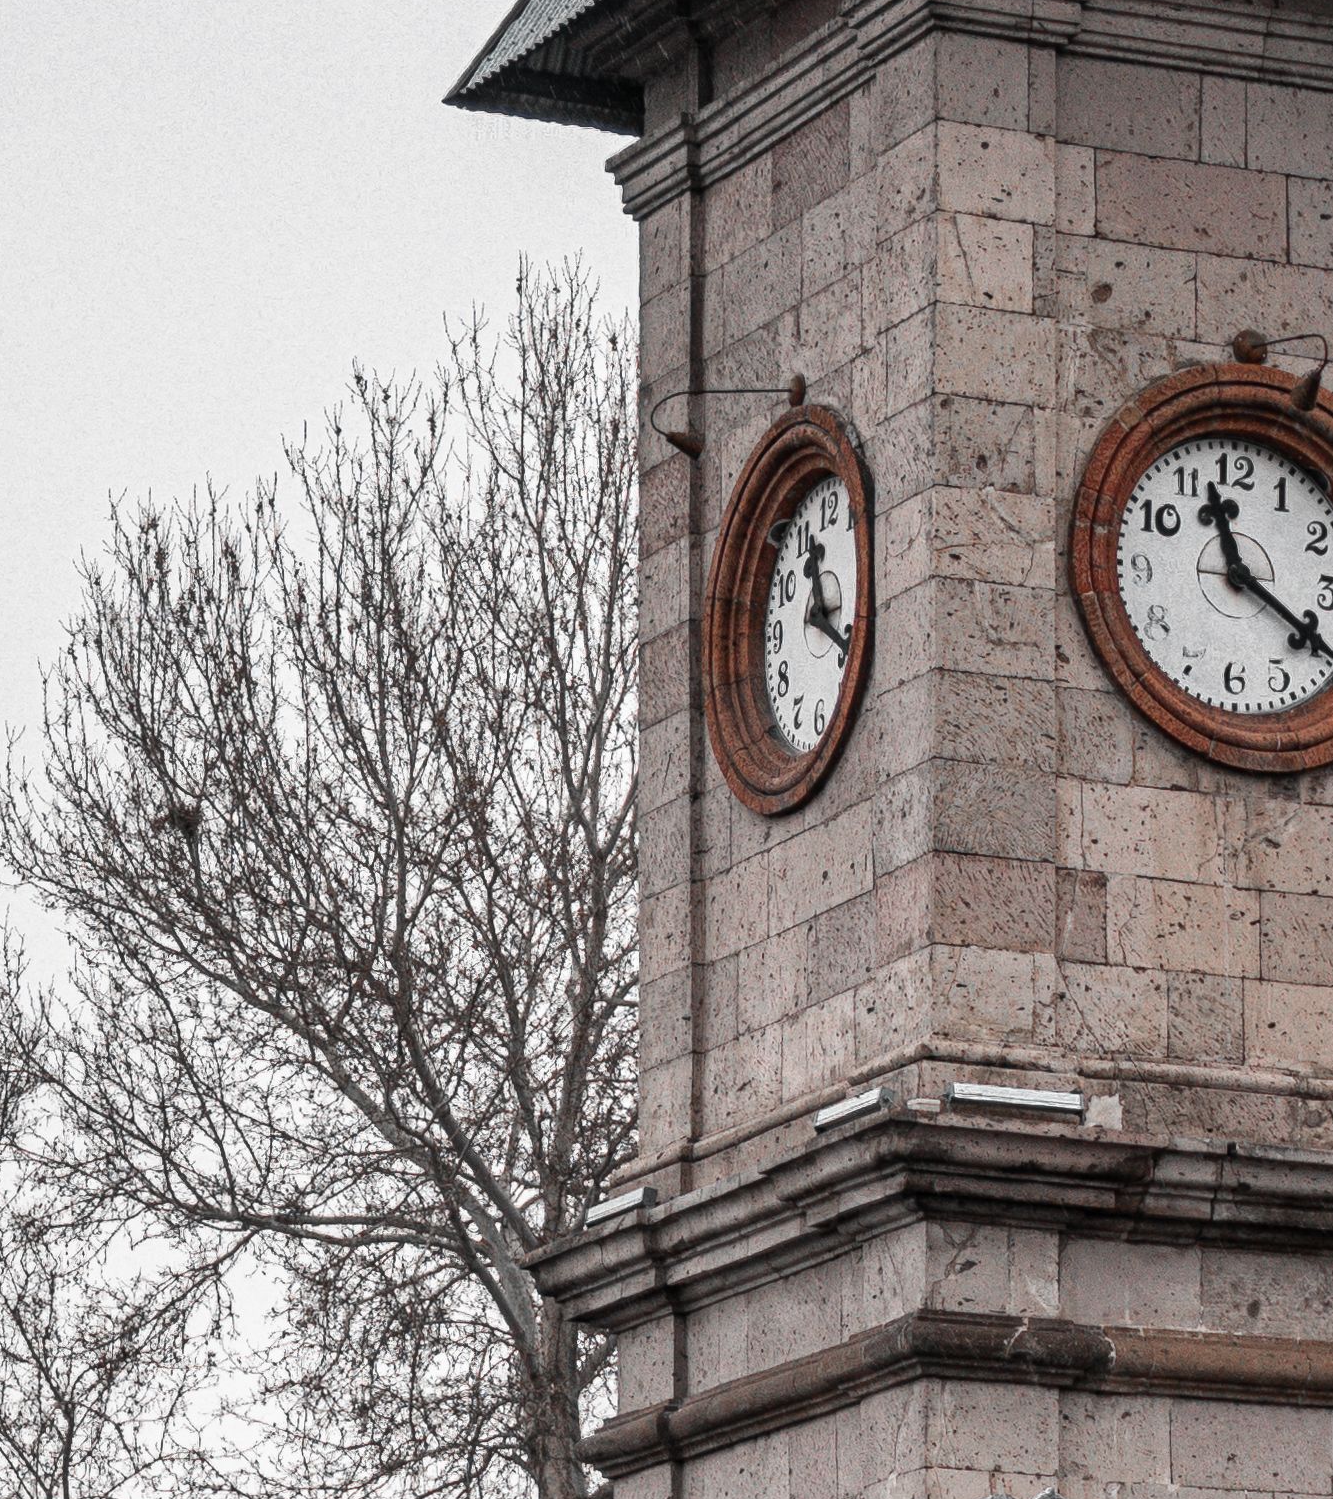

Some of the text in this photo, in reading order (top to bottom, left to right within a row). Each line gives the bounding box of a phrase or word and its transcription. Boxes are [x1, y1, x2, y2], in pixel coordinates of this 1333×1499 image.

[1173, 467, 1199, 497] 11
[1215, 453, 1255, 491] 12
[819, 491, 839, 532] 12
[1273, 477, 1290, 512] 1
[1139, 499, 1181, 537] 10
[796, 520, 811, 559] 11
[1305, 521, 1328, 556] 2
[1130, 553, 1153, 584] 9
[778, 570, 796, 608] 10
[773, 620, 783, 654] 9
[1144, 604, 1171, 641] 8
[777, 660, 789, 697] 8
[1223, 661, 1246, 695] 6
[1268, 658, 1291, 693] 5
[792, 692, 804, 730] 7
[814, 699, 825, 735] 6
